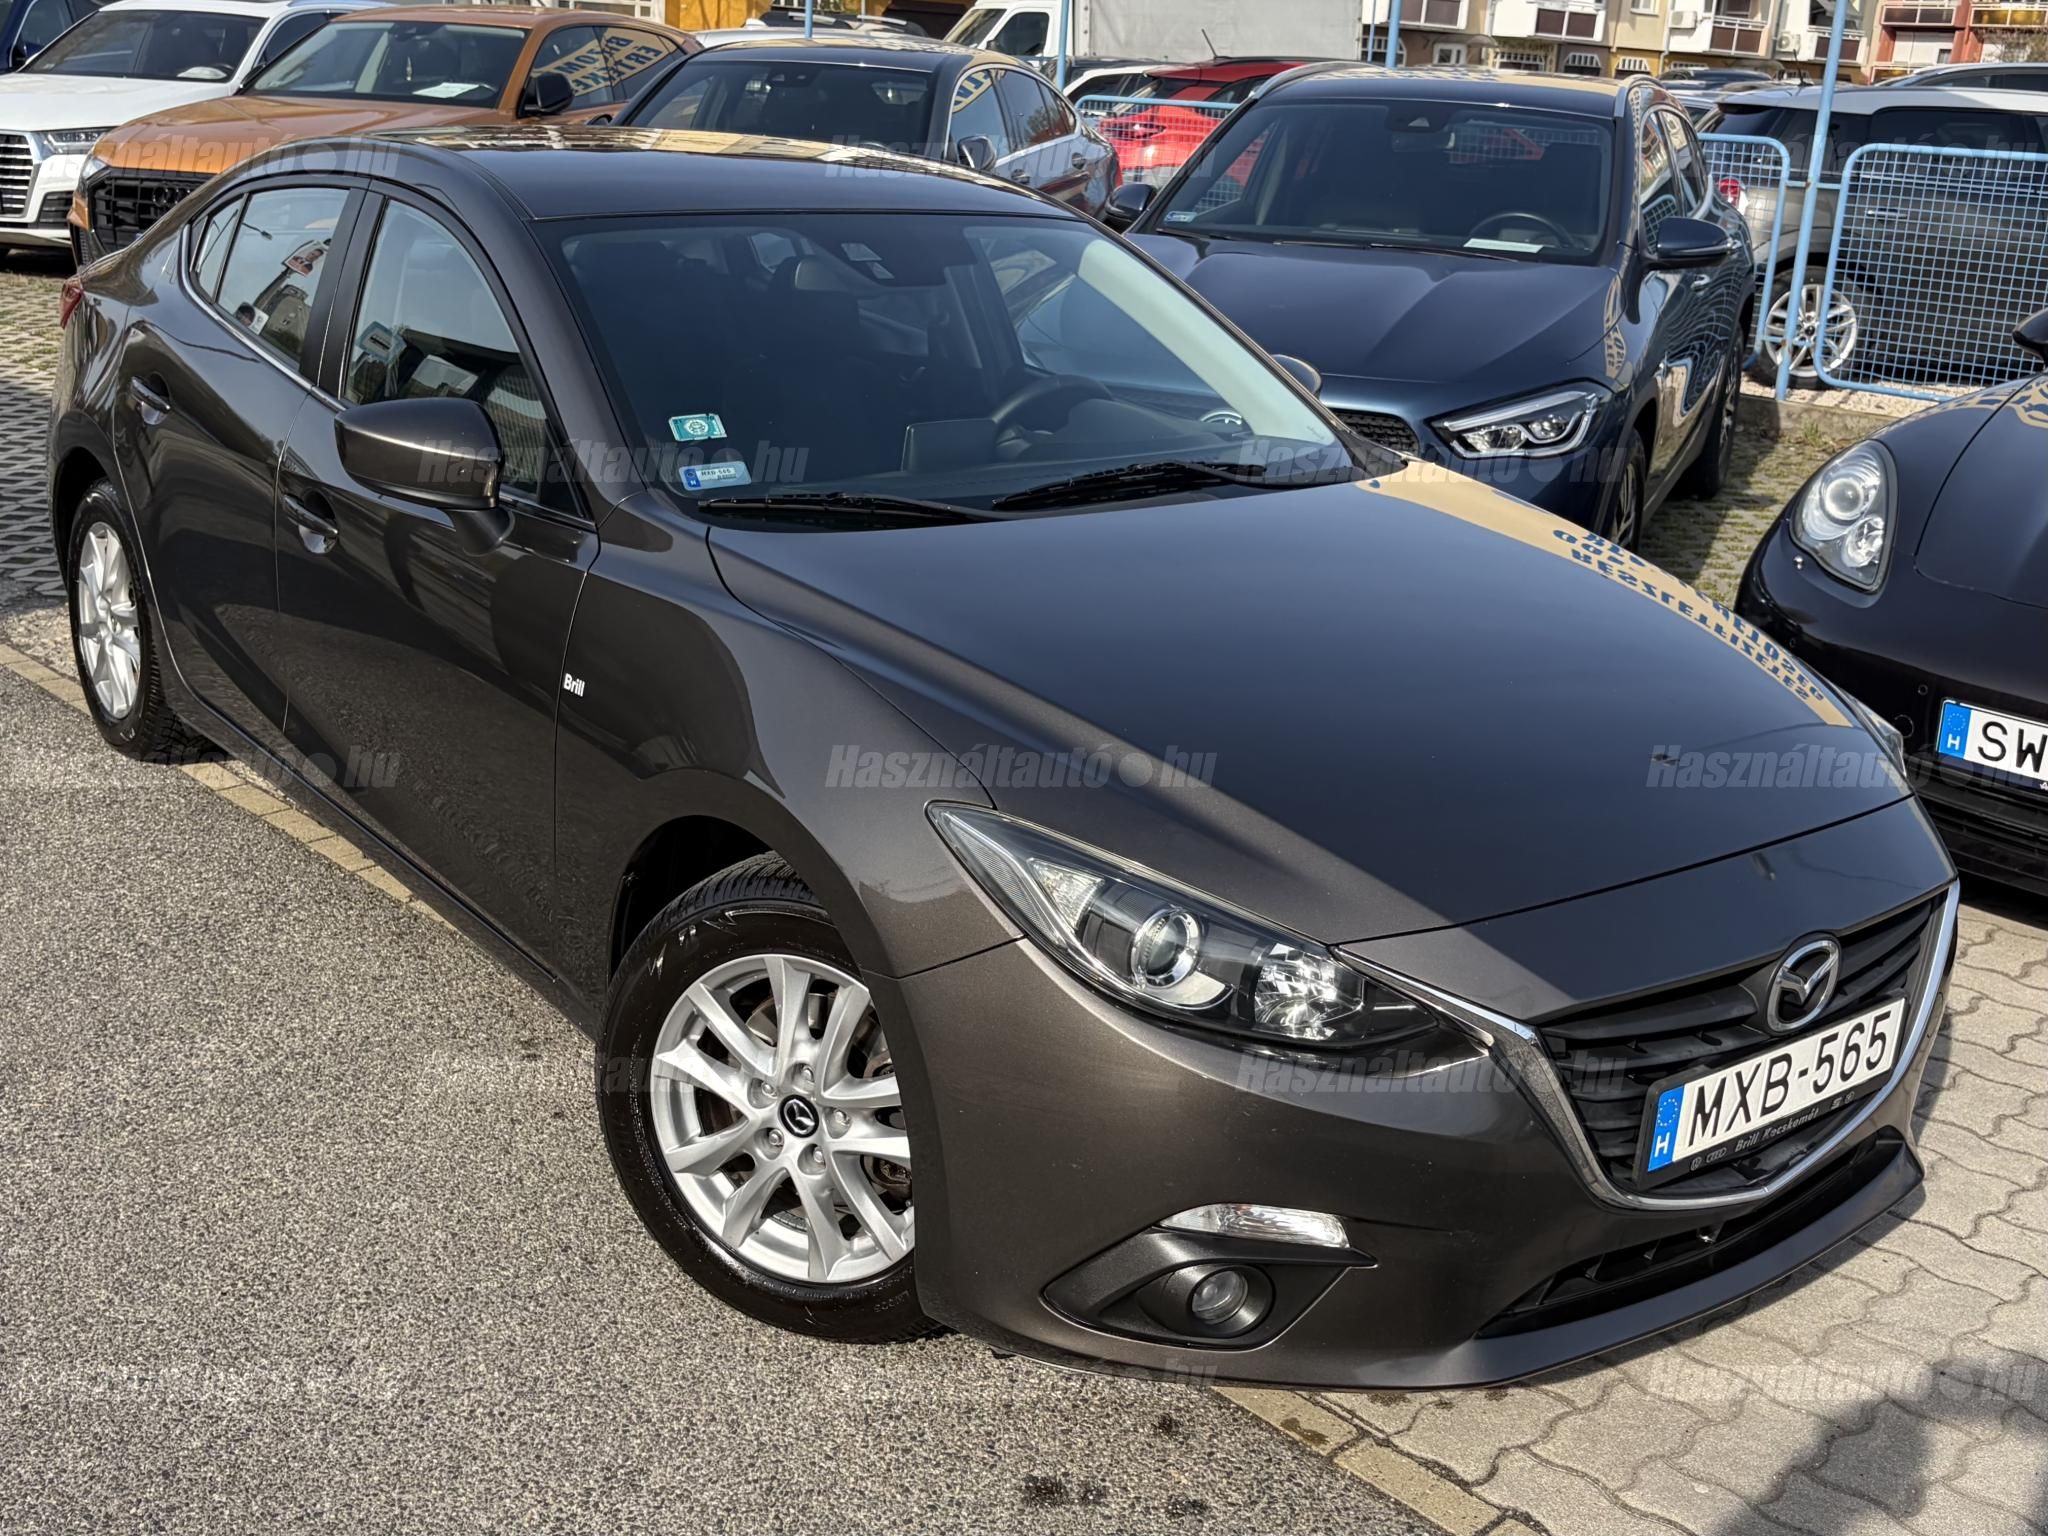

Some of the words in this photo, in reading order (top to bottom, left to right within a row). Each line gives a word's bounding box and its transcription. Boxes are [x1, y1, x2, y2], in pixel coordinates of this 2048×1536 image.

[563, 673, 585, 697] Brill
[1947, 733, 1961, 751] H
[1688, 1011, 1892, 1147] MXB-565
[1654, 1132, 1671, 1158] H
[1734, 1134, 1760, 1153] Brill
